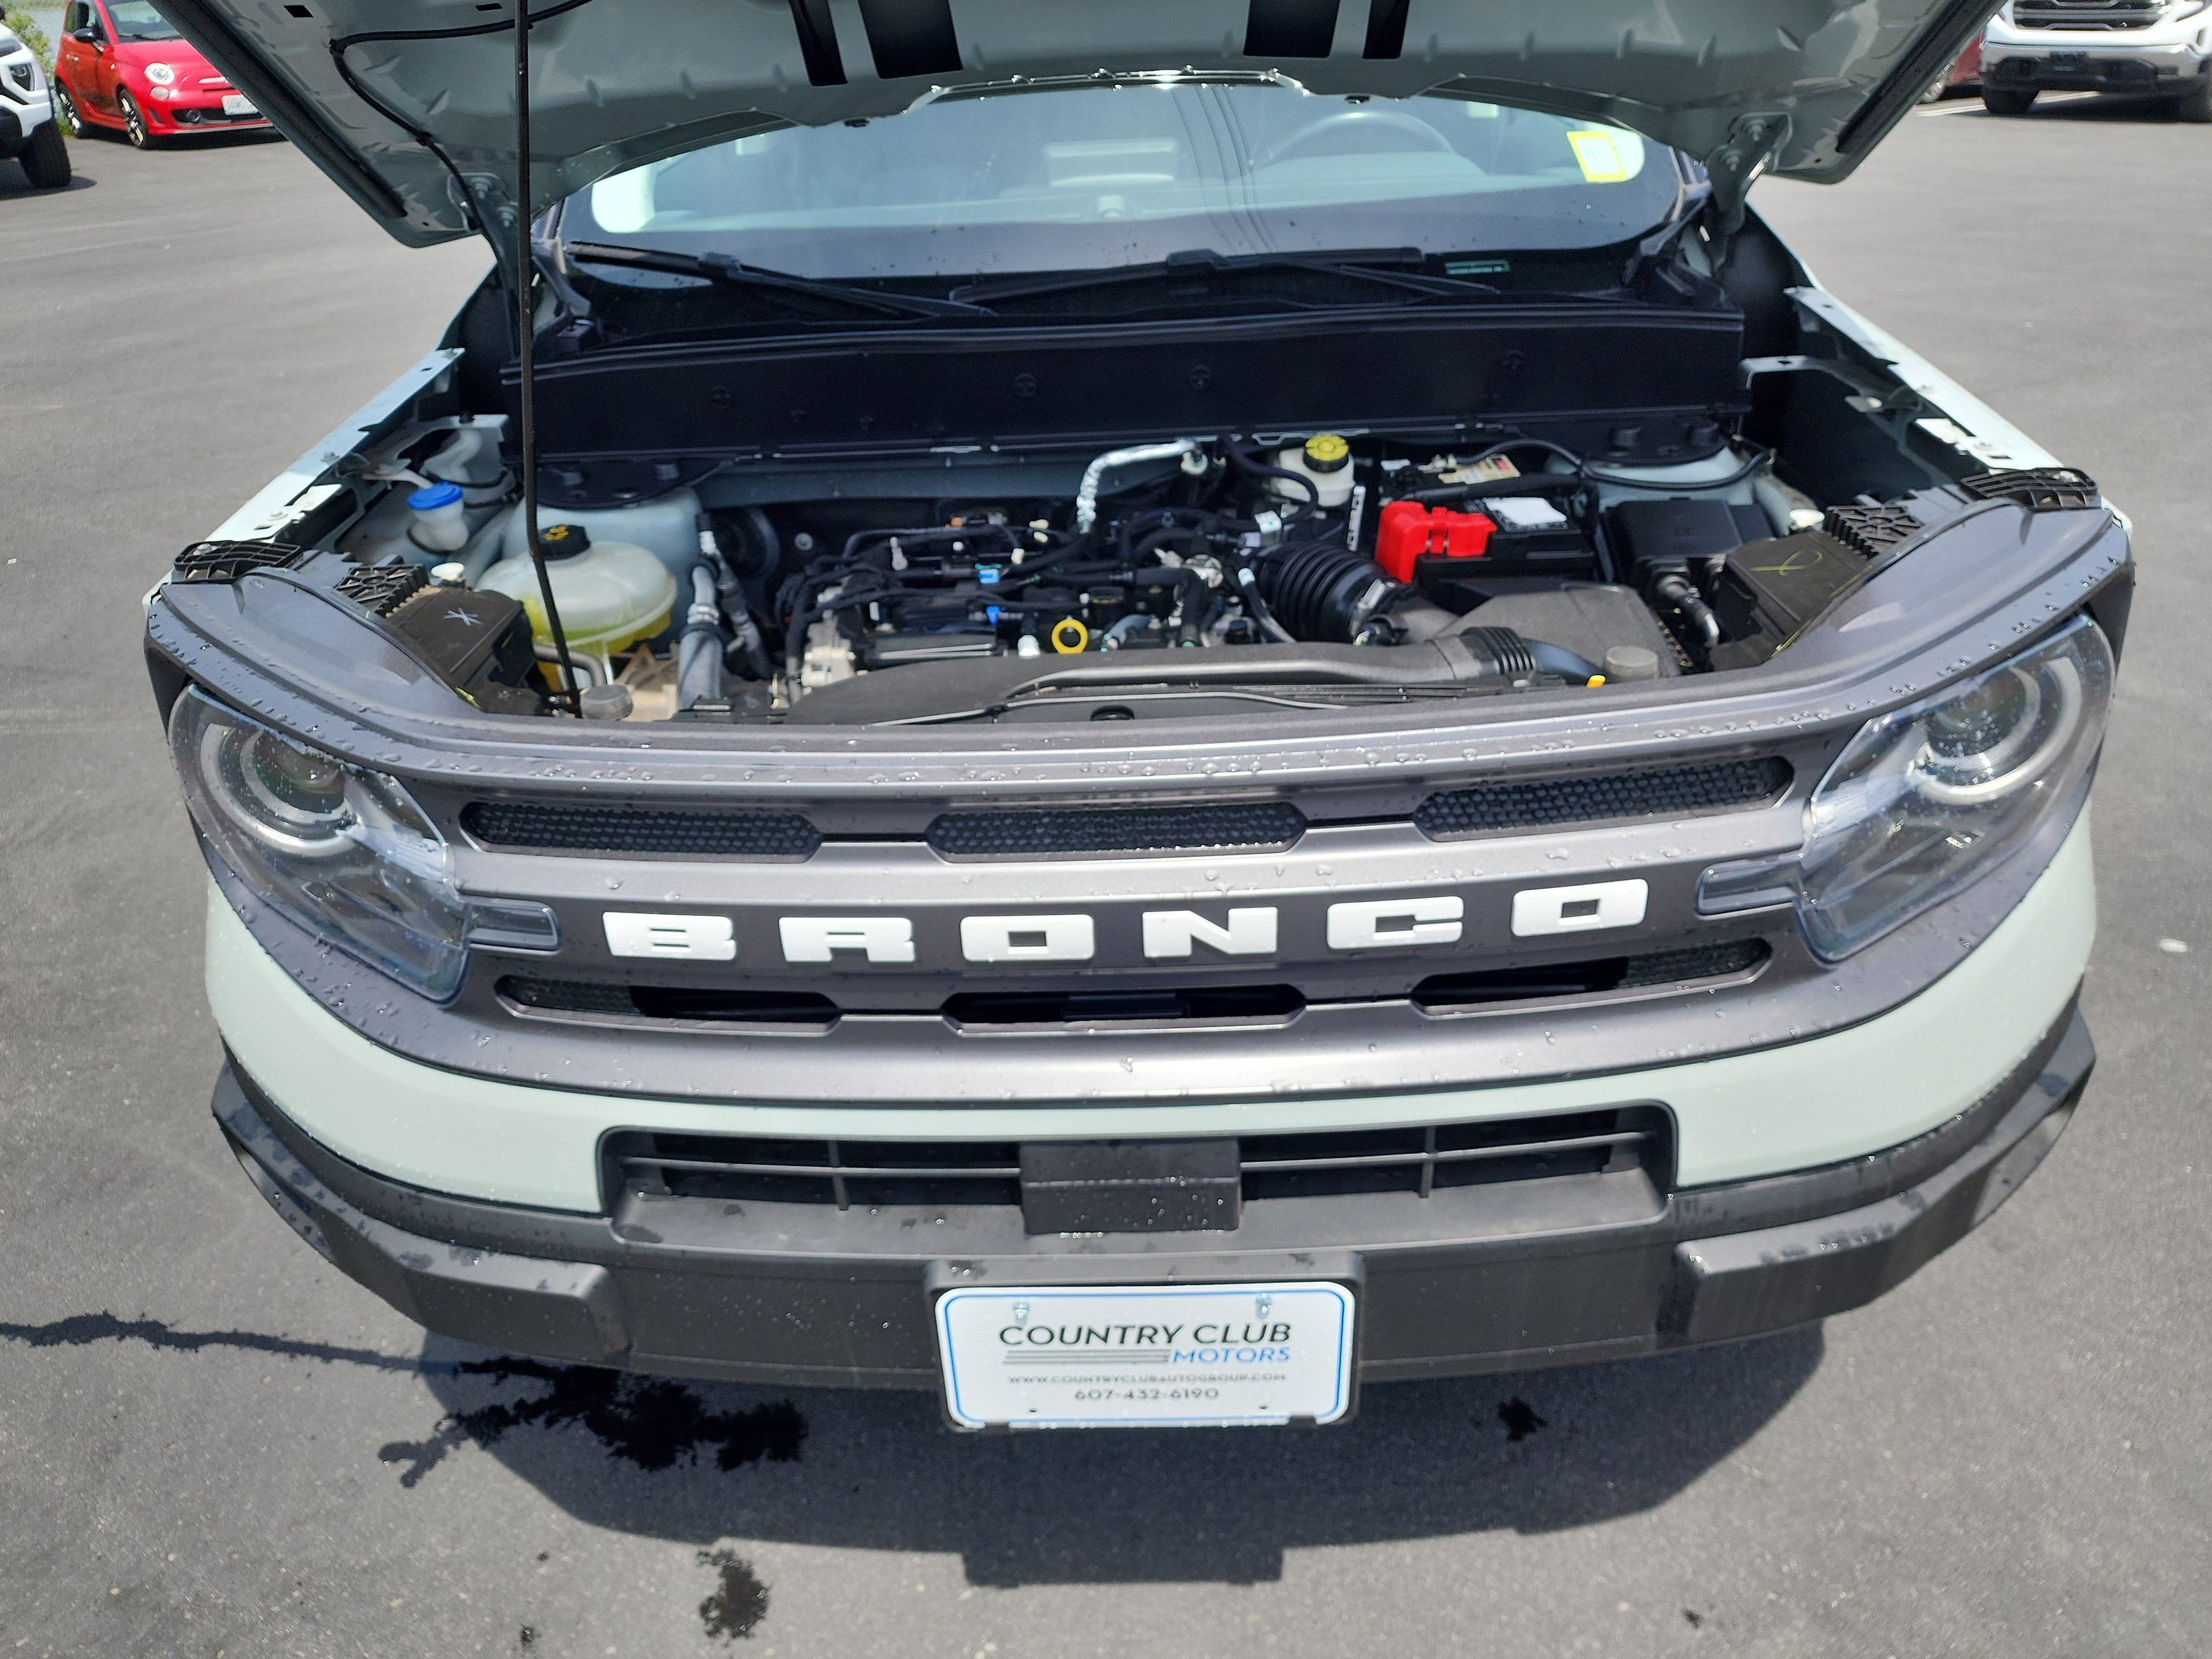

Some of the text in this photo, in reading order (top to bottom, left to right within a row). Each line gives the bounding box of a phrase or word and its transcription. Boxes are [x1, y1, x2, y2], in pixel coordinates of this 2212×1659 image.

[602, 878, 1650, 963] BRONCO
[999, 1322, 1291, 1345] COUNTRY CLUB
[1172, 1347, 1291, 1364] MOTORS
[1009, 1373, 1287, 1383] WWW.COUNTRYCLUBAUTOGROUP.COM
[1074, 1387, 1219, 1400] 607-432-6190
